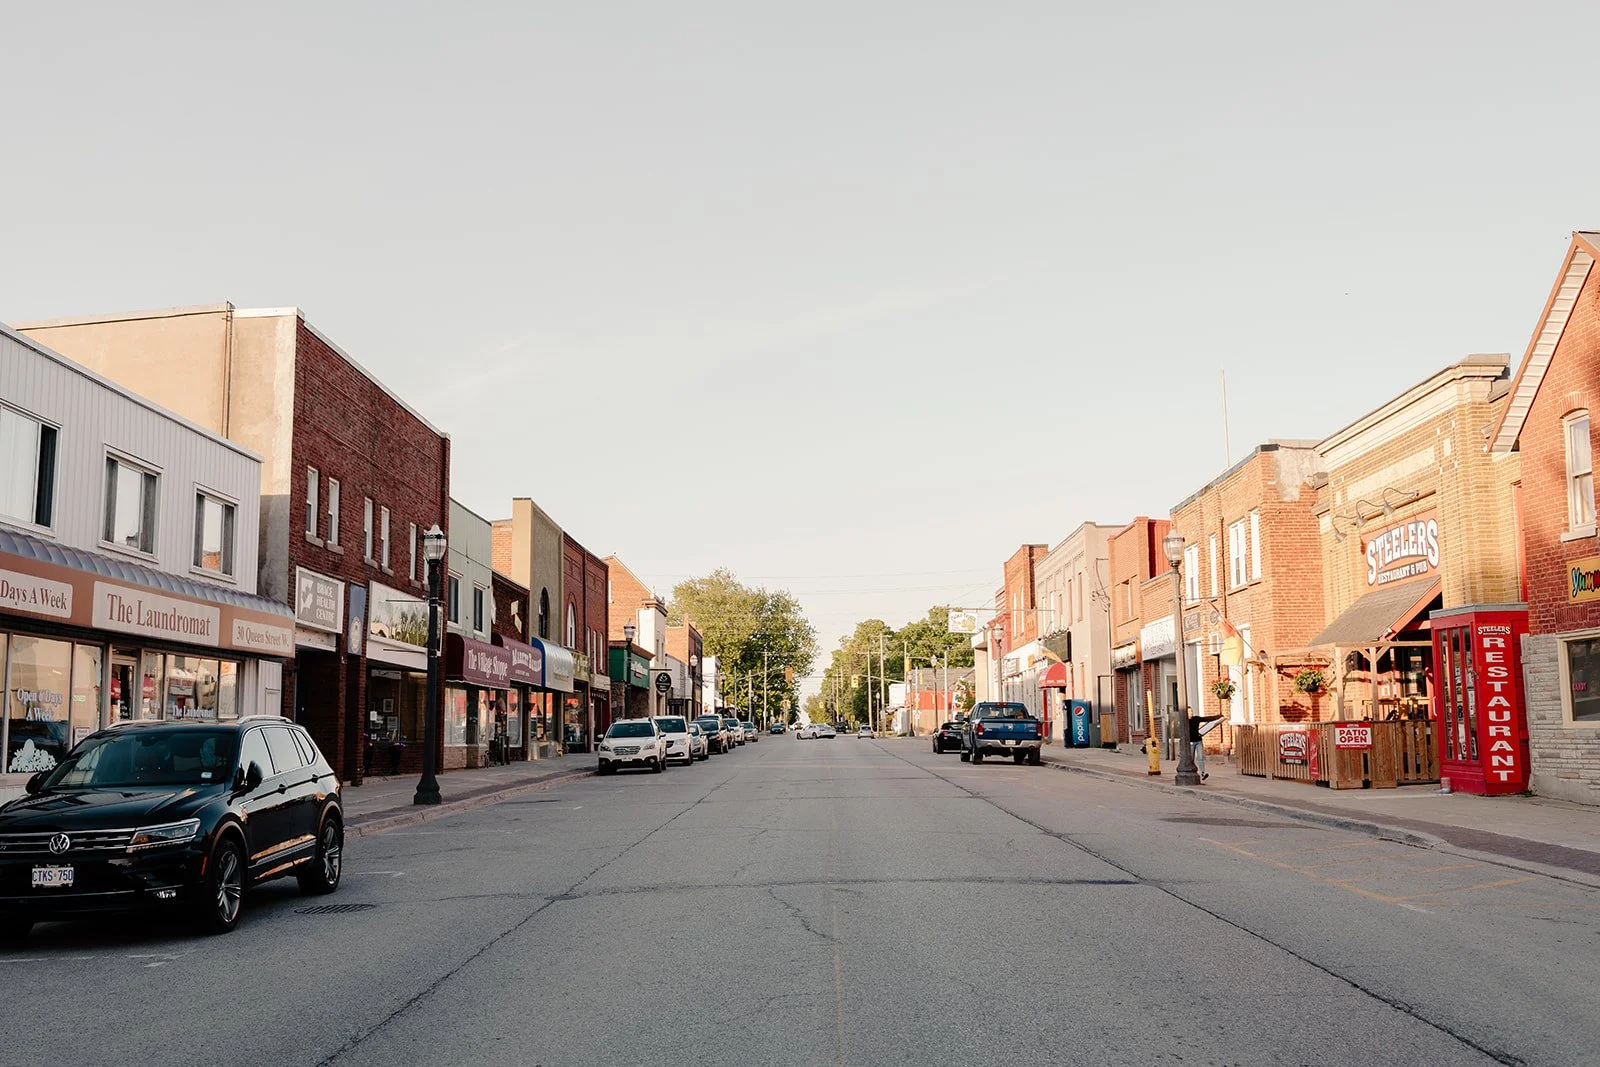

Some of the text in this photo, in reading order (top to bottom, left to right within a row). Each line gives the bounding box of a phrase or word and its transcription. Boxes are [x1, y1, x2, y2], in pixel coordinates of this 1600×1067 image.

[1367, 518, 1440, 586] STEELERS
[0, 579, 67, 610] Days A Week
[107, 593, 211, 637] The Laundromat
[236, 626, 245, 640] 30
[245, 627, 264, 644] Queen
[265, 630, 281, 645] Street
[1478, 625, 1511, 635] STEELERS
[17, 687, 37, 706] Open
[45, 689, 64, 708] Days
[26, 707, 33, 722] A
[1482, 637, 1515, 782] RESTAURANT
[1077, 718, 1086, 742] pepsi
[1280, 732, 1306, 755] STEELERS
